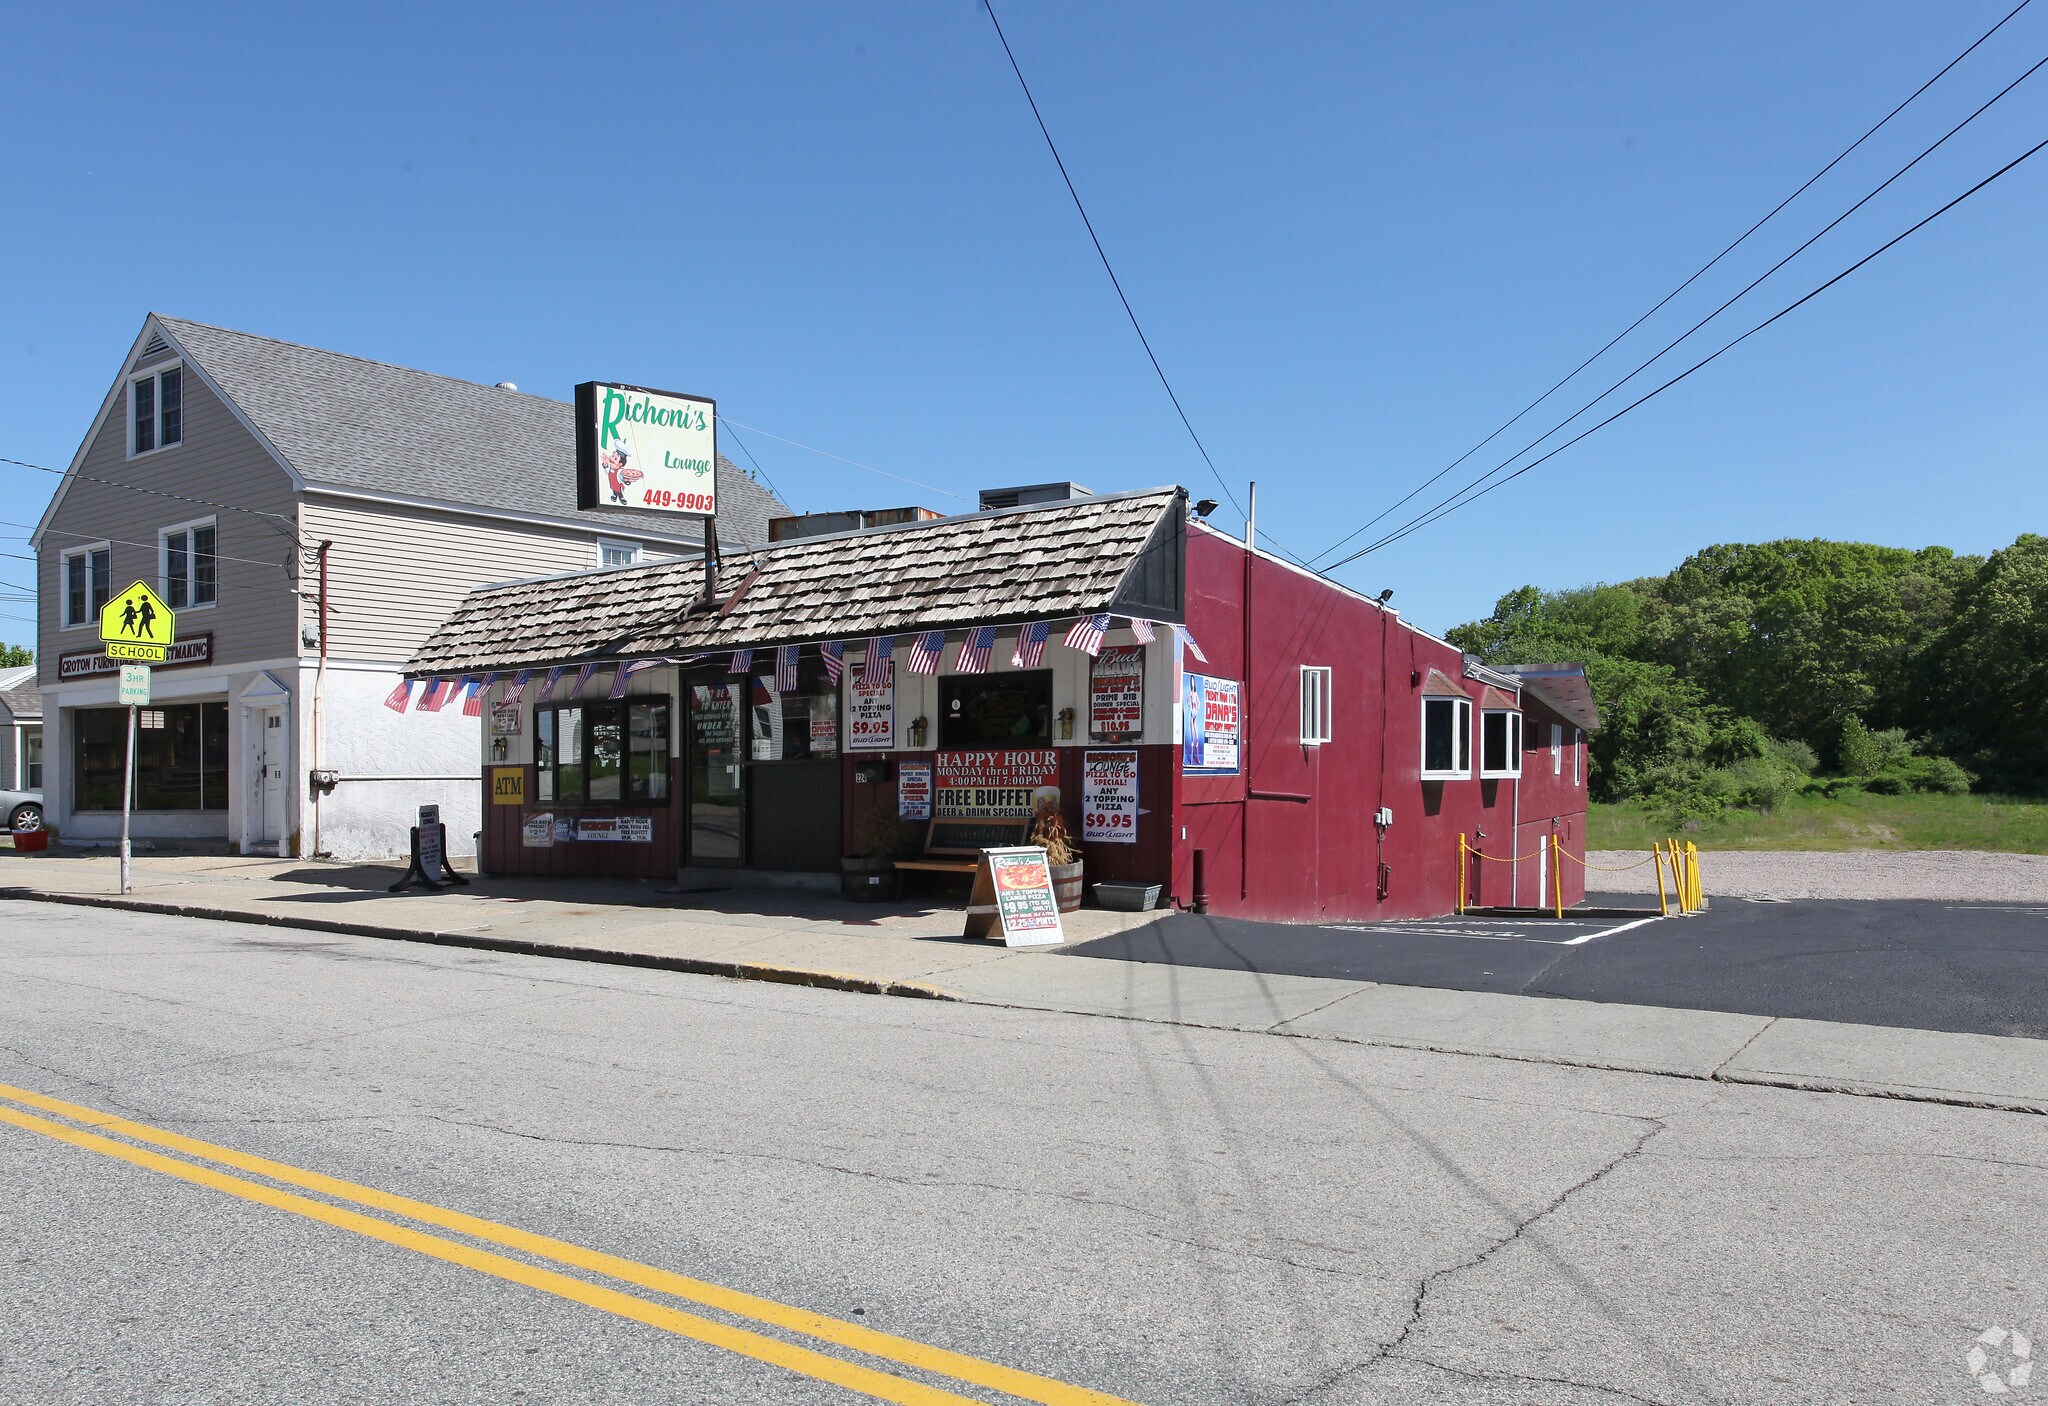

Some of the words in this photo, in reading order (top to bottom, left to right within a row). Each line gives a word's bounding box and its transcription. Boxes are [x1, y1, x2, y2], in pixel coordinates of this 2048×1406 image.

[601, 387, 709, 450] Richoni's
[664, 450, 712, 477] Lounge
[642, 488, 714, 511] 449-9903
[110, 645, 162, 659] SCHOOL
[1096, 648, 1141, 664] Bud
[62, 659, 90, 674] GROTON
[1094, 661, 1142, 676] HEAVY
[126, 672, 132, 683] 3
[133, 675, 144, 683] HR
[121, 687, 147, 696] PARKING
[1095, 694, 1118, 702] PRIME
[1122, 693, 1137, 701] RIB
[1205, 702, 1237, 723] DANA'S
[696, 722, 722, 730] UNDER
[852, 721, 890, 735] $9.95
[937, 752, 998, 767] HAPPY
[1004, 751, 1057, 766] HOUR
[937, 767, 984, 776] MONDAY
[986, 766, 1008, 775] thru
[1012, 765, 1057, 775] FRIDAY
[1089, 760, 1130, 773] LOUNGE
[495, 777, 522, 795] ATM
[949, 777, 985, 785] 4:00PM
[988, 777, 1000, 785] til
[1003, 775, 1042, 785] 7:00PM
[937, 789, 971, 806] FREE
[975, 788, 1033, 806] BUFFET
[1093, 795, 1135, 803] TOPPING
[937, 808, 957, 817] BEER
[958, 808, 964, 816] &
[965, 807, 991, 817] DRINK
[993, 807, 1033, 817] SPECIALS
[1086, 812, 1132, 828] $9.95
[1105, 829, 1134, 839] LIGHT
[1004, 901, 1028, 913] $9.95
[1036, 917, 1056, 926] PINTS
